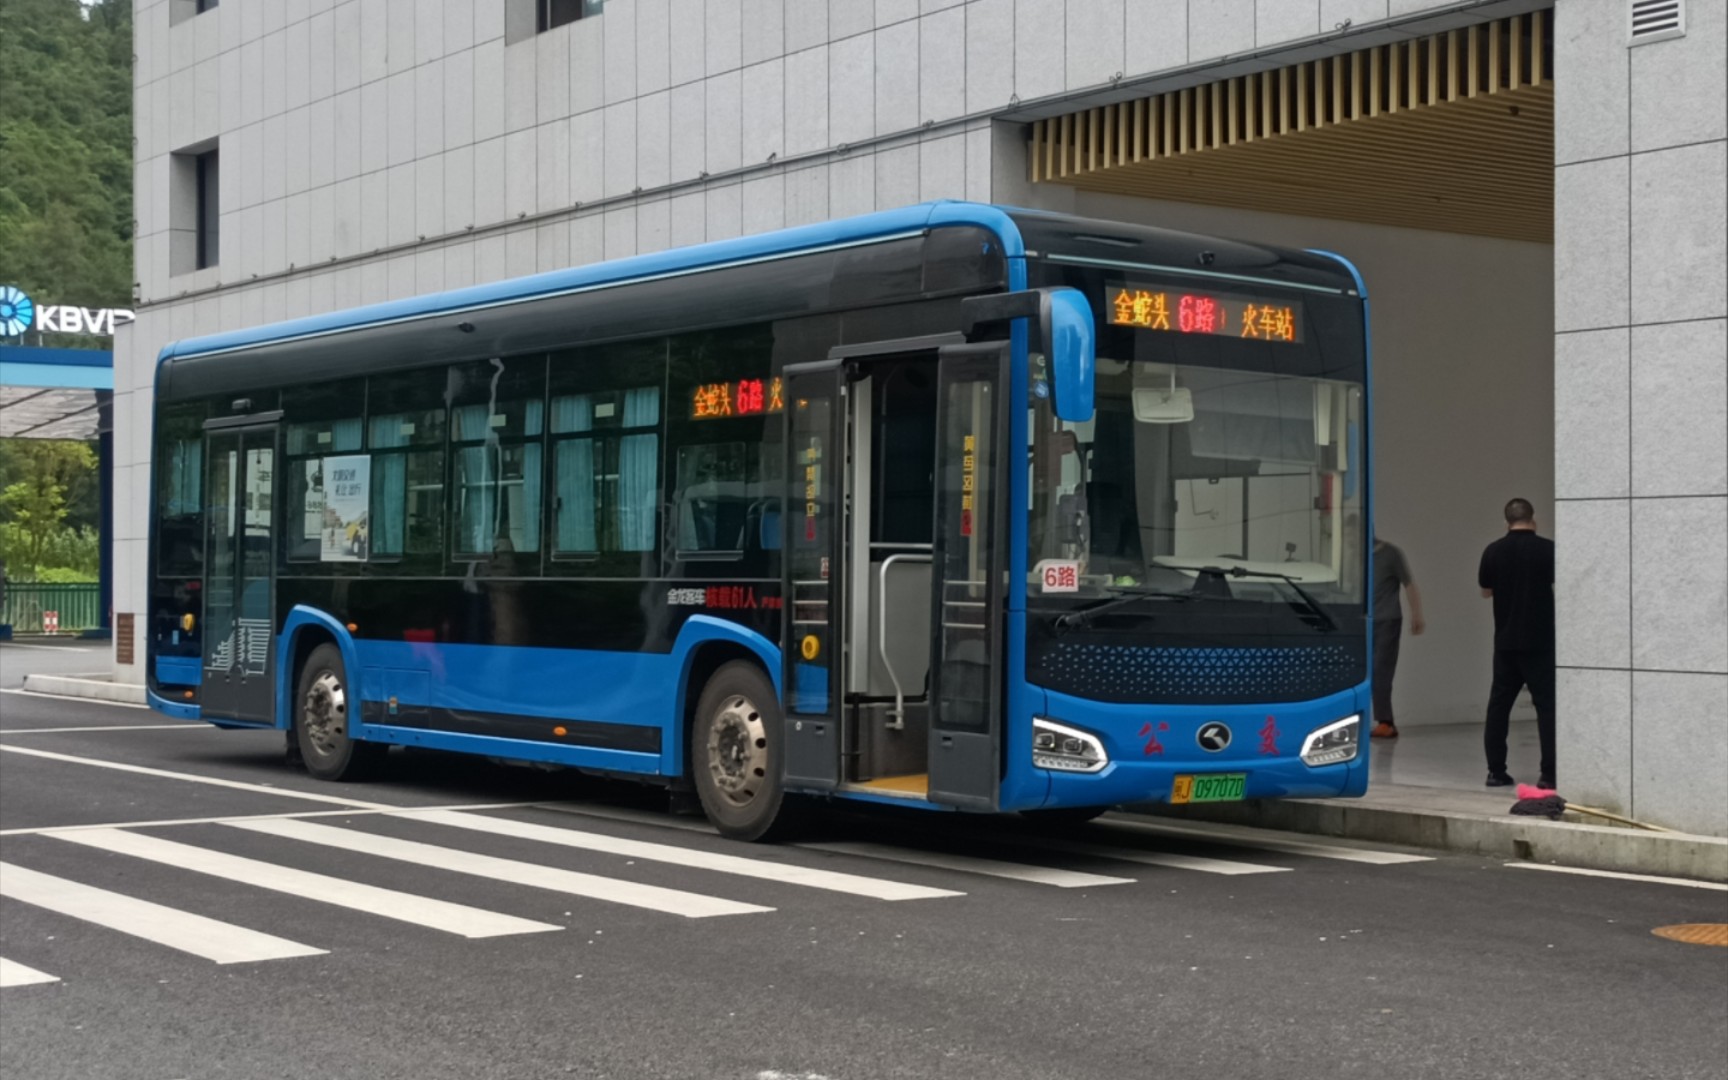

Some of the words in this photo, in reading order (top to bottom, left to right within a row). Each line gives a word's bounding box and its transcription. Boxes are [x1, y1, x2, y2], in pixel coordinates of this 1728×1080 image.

[1113, 288, 1170, 330] 金蛇头
[1178, 295, 1218, 333] 6路
[1240, 303, 1296, 341] 火车站
[737, 377, 765, 415] 6路
[1044, 565, 1076, 588] 6路
